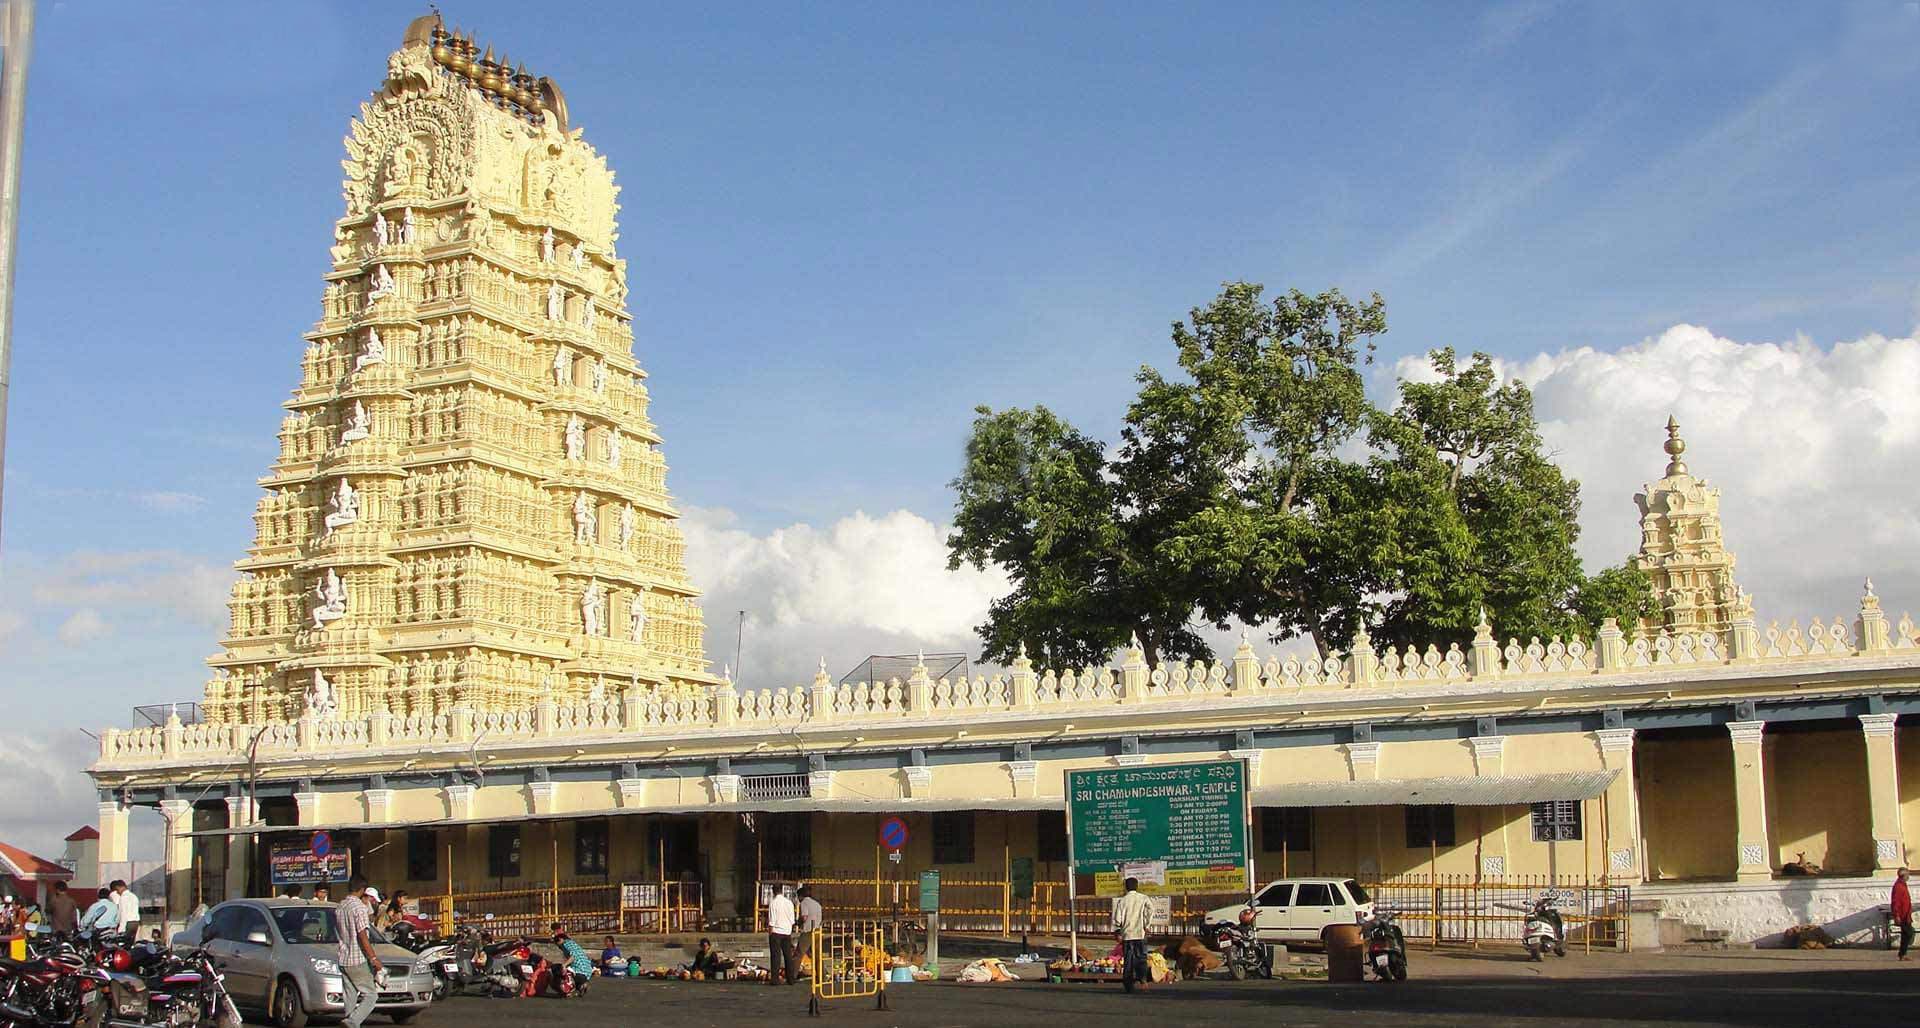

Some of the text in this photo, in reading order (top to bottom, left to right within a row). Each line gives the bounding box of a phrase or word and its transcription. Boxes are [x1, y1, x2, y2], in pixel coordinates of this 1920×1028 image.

[1076, 782, 1237, 801] SRI CHAMUNDESHWARI TEMPLE
